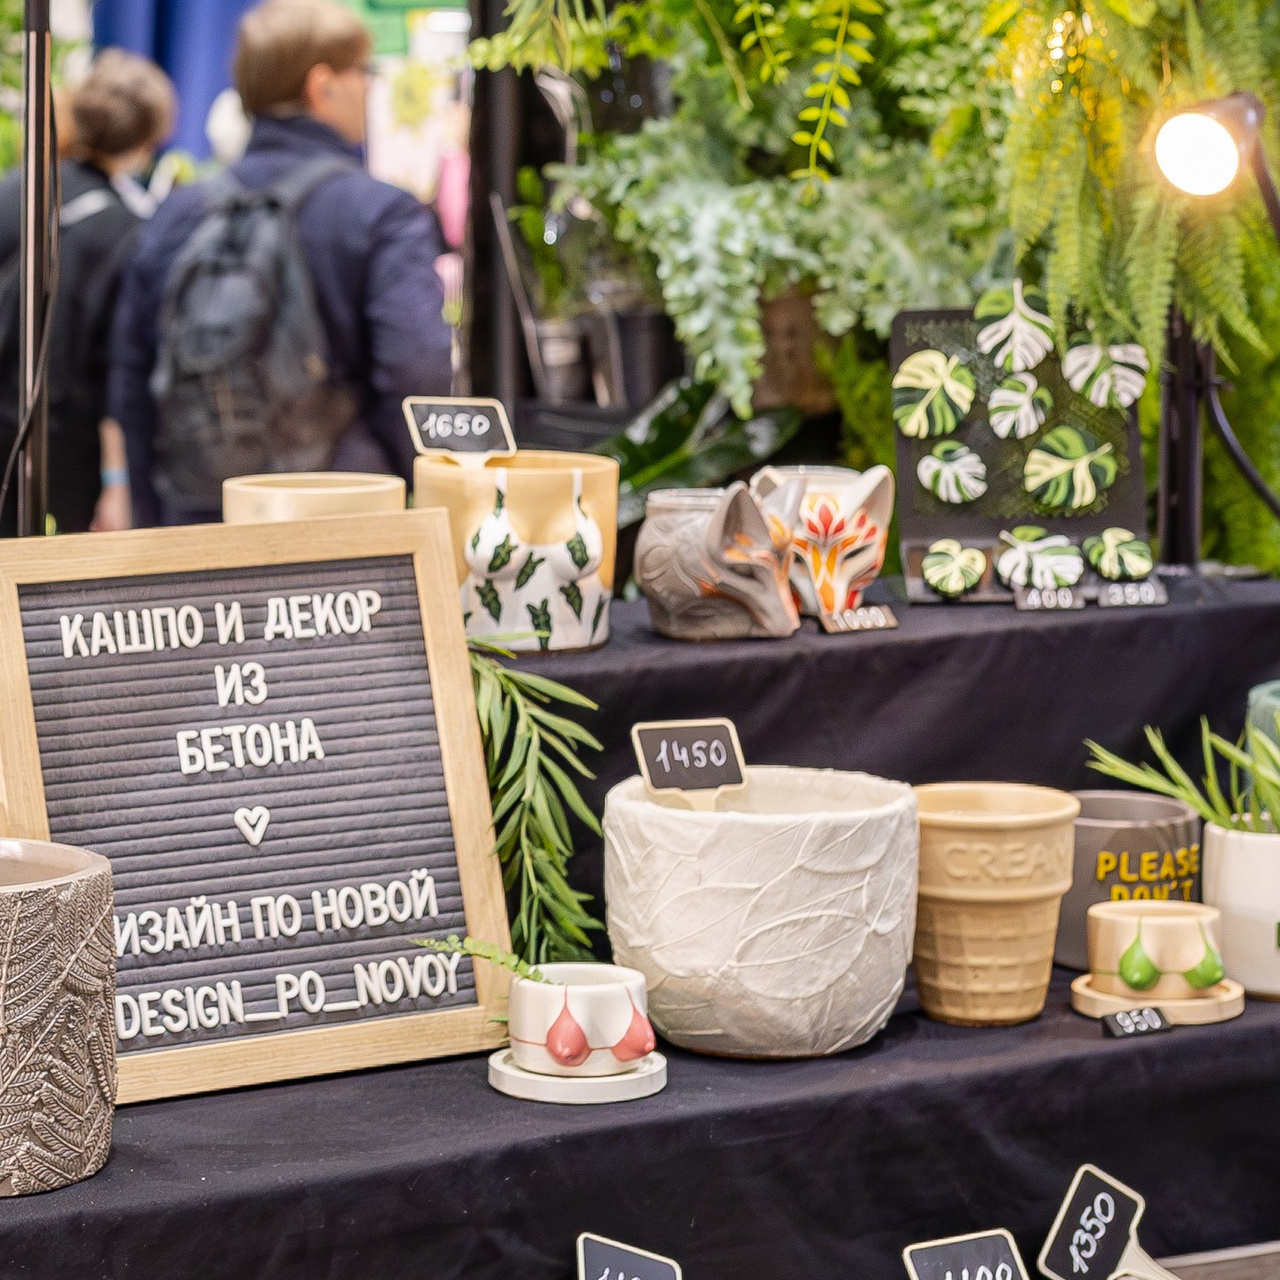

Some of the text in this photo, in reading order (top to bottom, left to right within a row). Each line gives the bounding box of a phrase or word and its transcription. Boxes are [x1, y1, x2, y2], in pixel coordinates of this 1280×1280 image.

[421, 413, 490, 439] 1650
[59, 588, 383, 660] КАШПО И ДЕКОР
[214, 662, 269, 709] ИЗ
[176, 718, 326, 776] БЕТОНА
[654, 737, 729, 772] 1450
[1096, 843, 1201, 884] PLEASE
[114, 867, 440, 958] ИЗАЙН ПО НОВОЙ
[1115, 1006, 1163, 1034] 950
[1069, 1191, 1115, 1274] 1350
